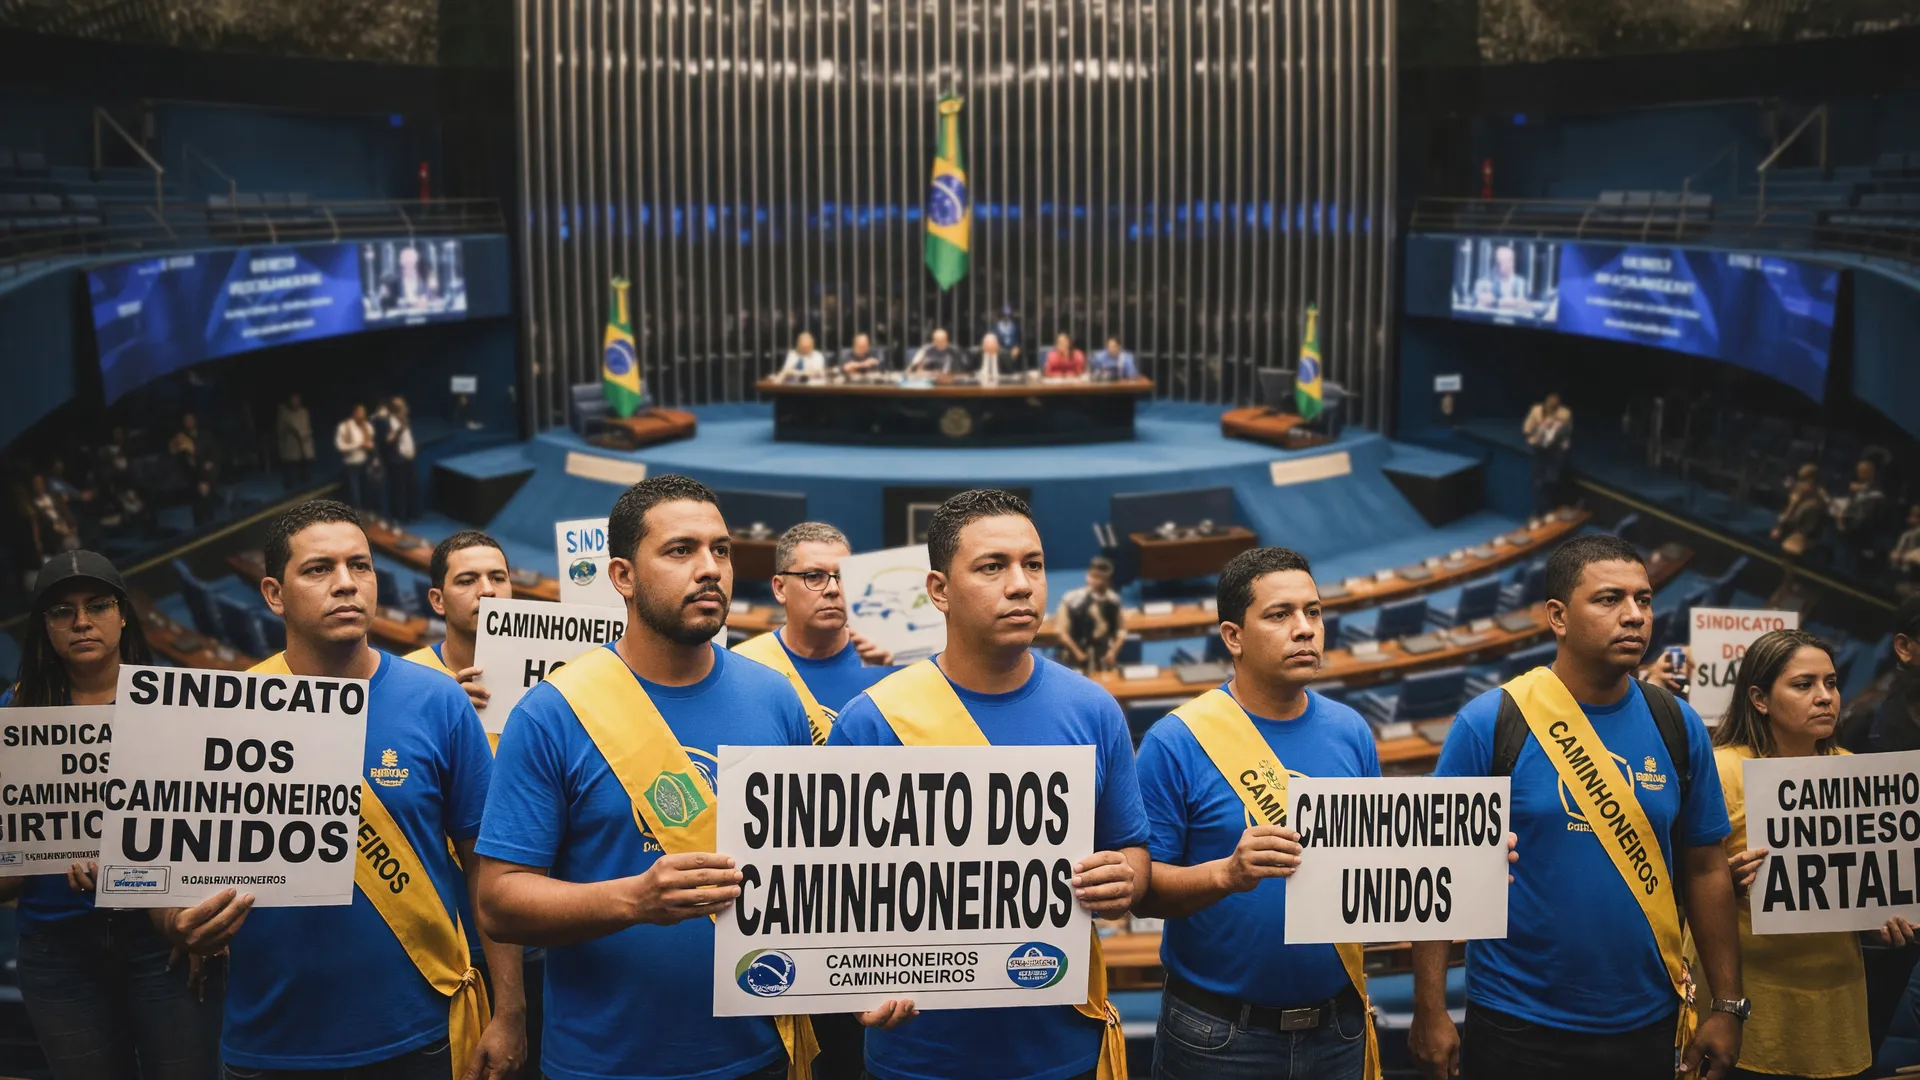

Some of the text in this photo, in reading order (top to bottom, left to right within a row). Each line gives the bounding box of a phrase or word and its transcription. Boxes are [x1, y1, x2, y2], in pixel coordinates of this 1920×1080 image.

[566, 528, 608, 553] SIND
[1696, 614, 1785, 632] SINDICATO
[129, 670, 365, 716] SINDICATO
[3, 723, 112, 747] SINDICA
[61, 752, 110, 775] DOS
[204, 737, 295, 773] DOS
[105, 778, 362, 817] CAMINHONEIROS
[743, 771, 1070, 850] SINDICATO DOS
[1548, 720, 1659, 896] CAMINHONEIROS
[121, 817, 349, 863] UNIDOS
[1296, 792, 1502, 849] CAMINHONEIROS
[1766, 809, 1920, 849] UNDIESO
[735, 858, 1073, 937] CAMINHONEIROS
[1341, 866, 1452, 925] UNIDOS
[826, 951, 979, 970] CAMINHONEIROS
[829, 969, 976, 987] CAMINHONEIROS
